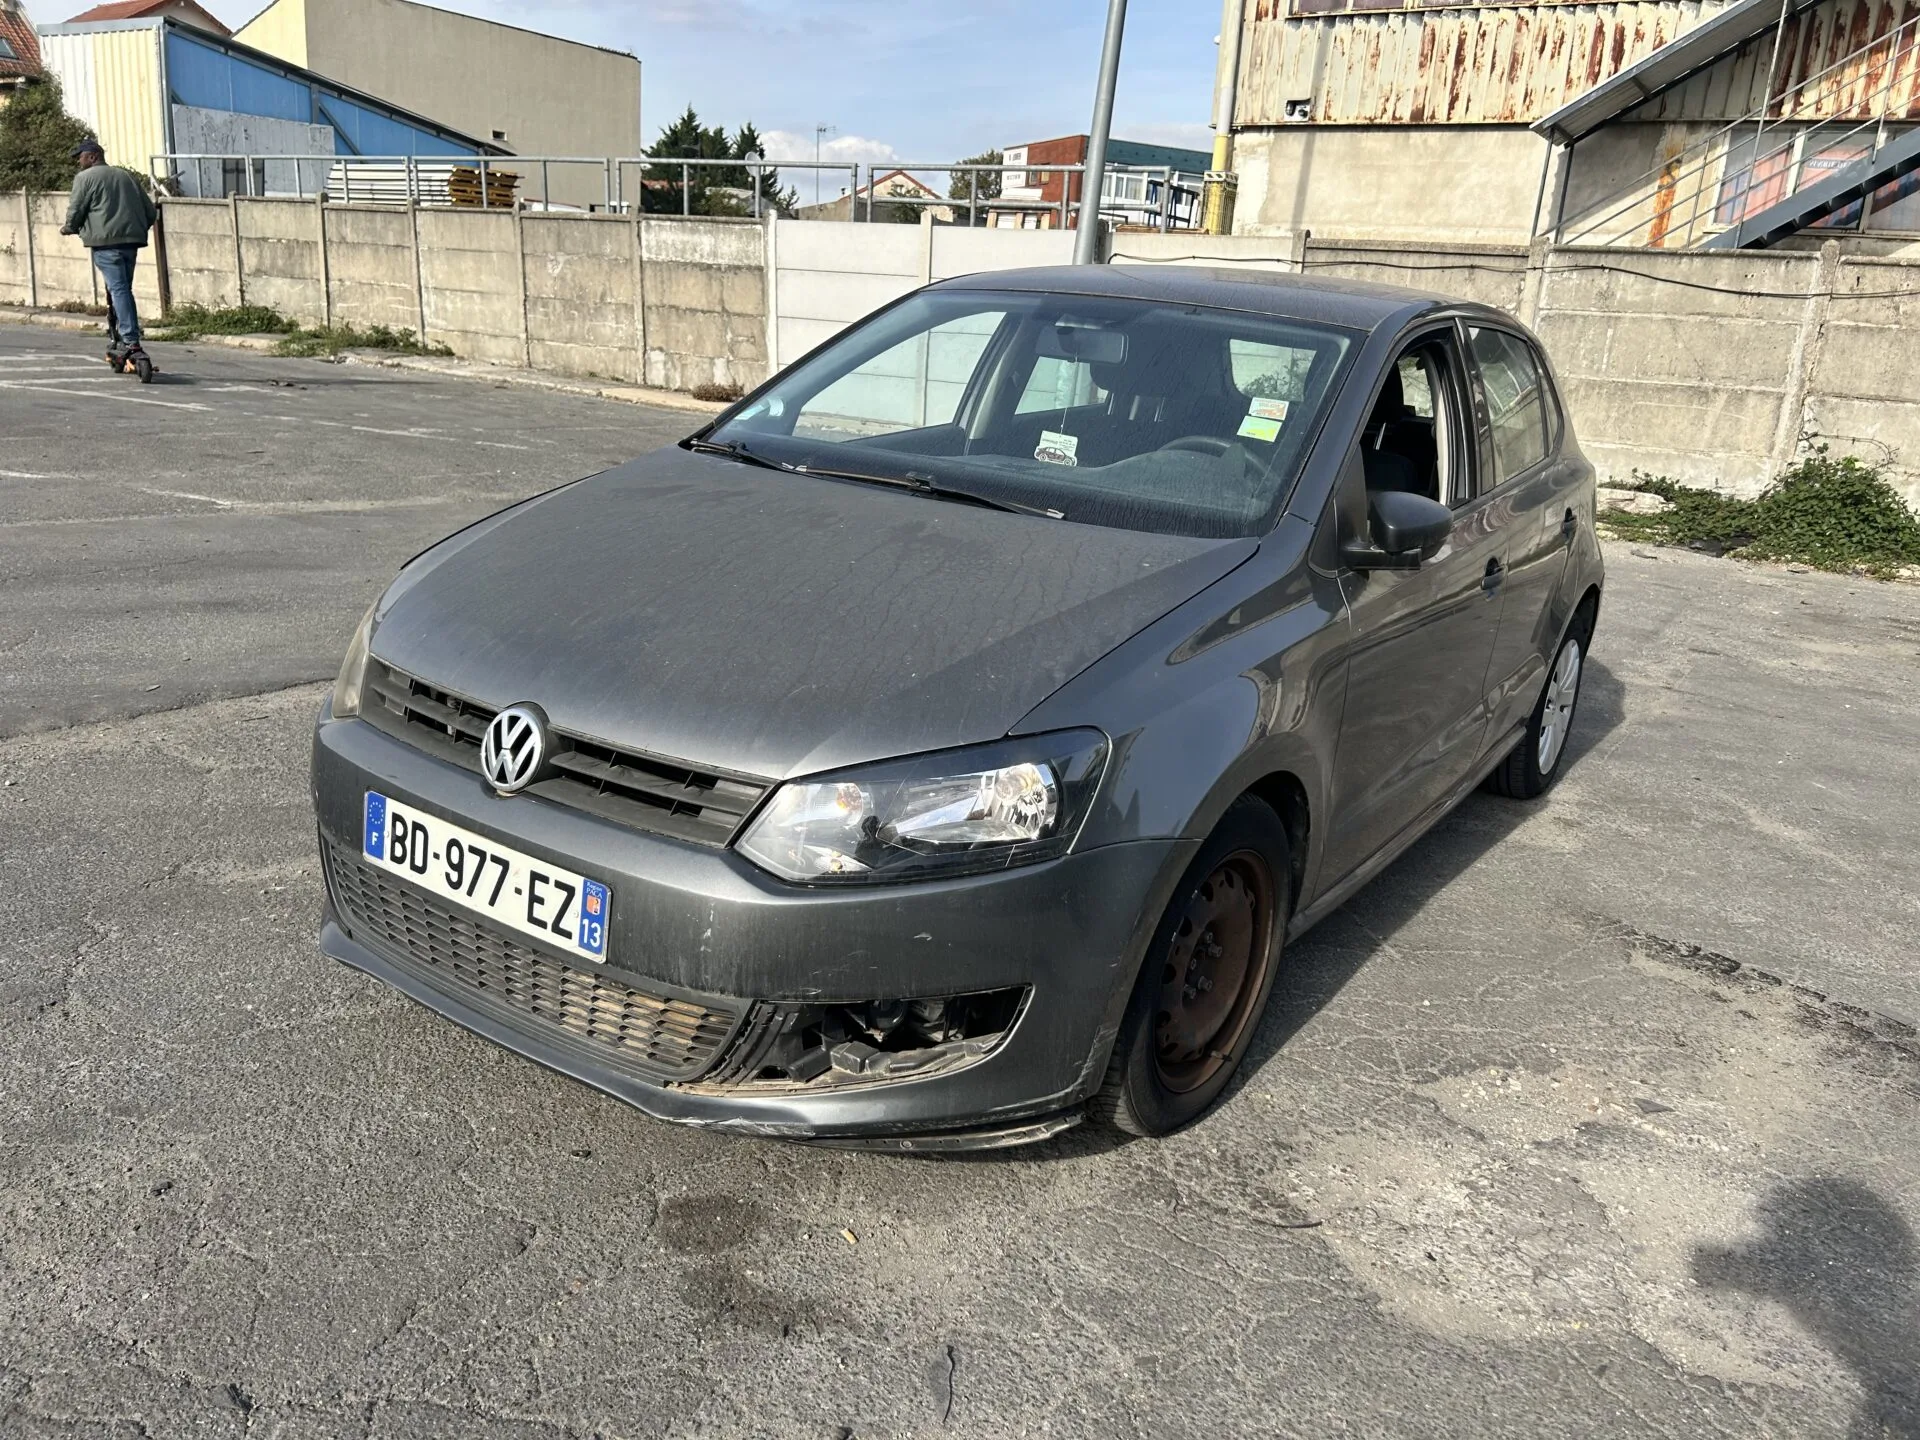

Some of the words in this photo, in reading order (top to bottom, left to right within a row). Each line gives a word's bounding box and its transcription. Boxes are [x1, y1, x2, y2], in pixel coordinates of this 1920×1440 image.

[483, 709, 541, 791] VW
[371, 832, 378, 845] F
[390, 812, 576, 940] BD-977-EZ
[586, 888, 603, 899] PACA
[582, 919, 601, 947] 13
